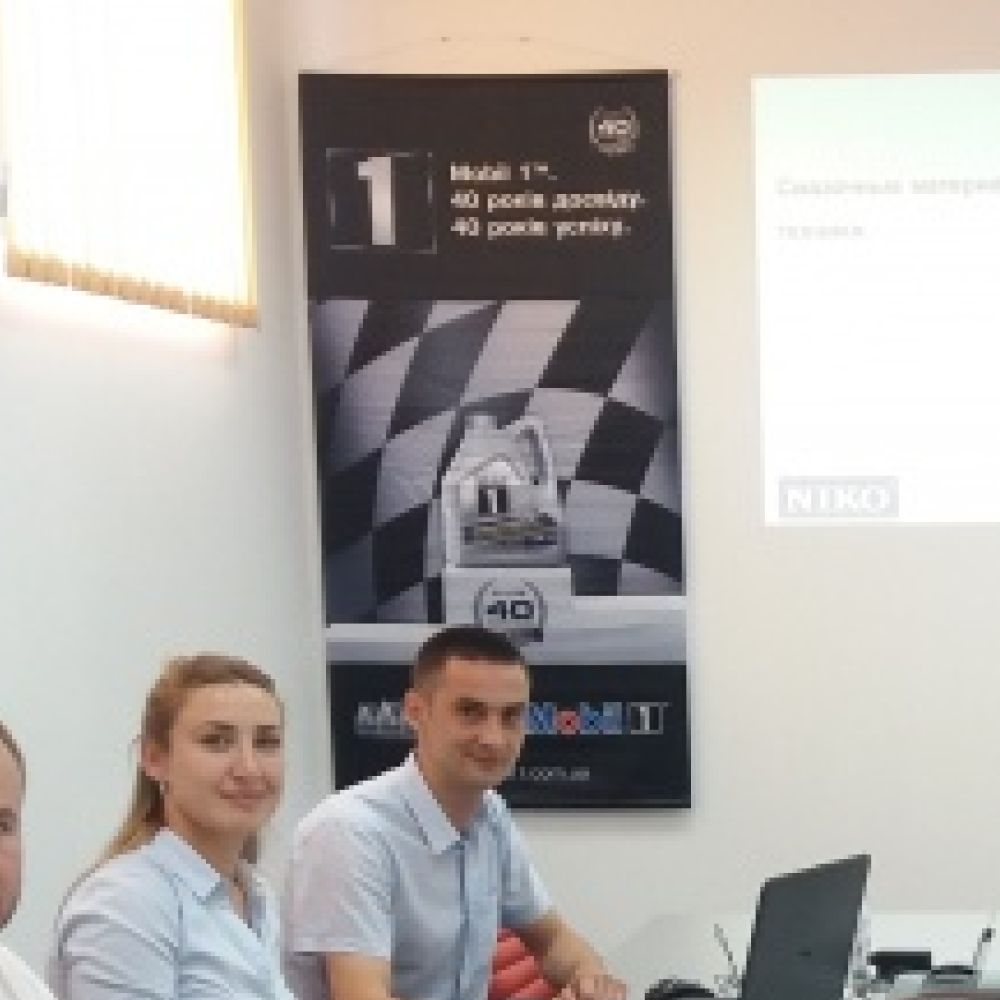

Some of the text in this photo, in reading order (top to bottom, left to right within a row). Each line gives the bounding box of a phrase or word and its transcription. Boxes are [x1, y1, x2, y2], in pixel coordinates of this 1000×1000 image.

[450, 161, 512, 181] Mobil
[357, 156, 396, 246] 1
[450, 189, 480, 209] 40
[450, 217, 480, 237] 40
[784, 487, 892, 514] NIKO
[487, 599, 535, 620] 40
[529, 701, 623, 735] Mobil
